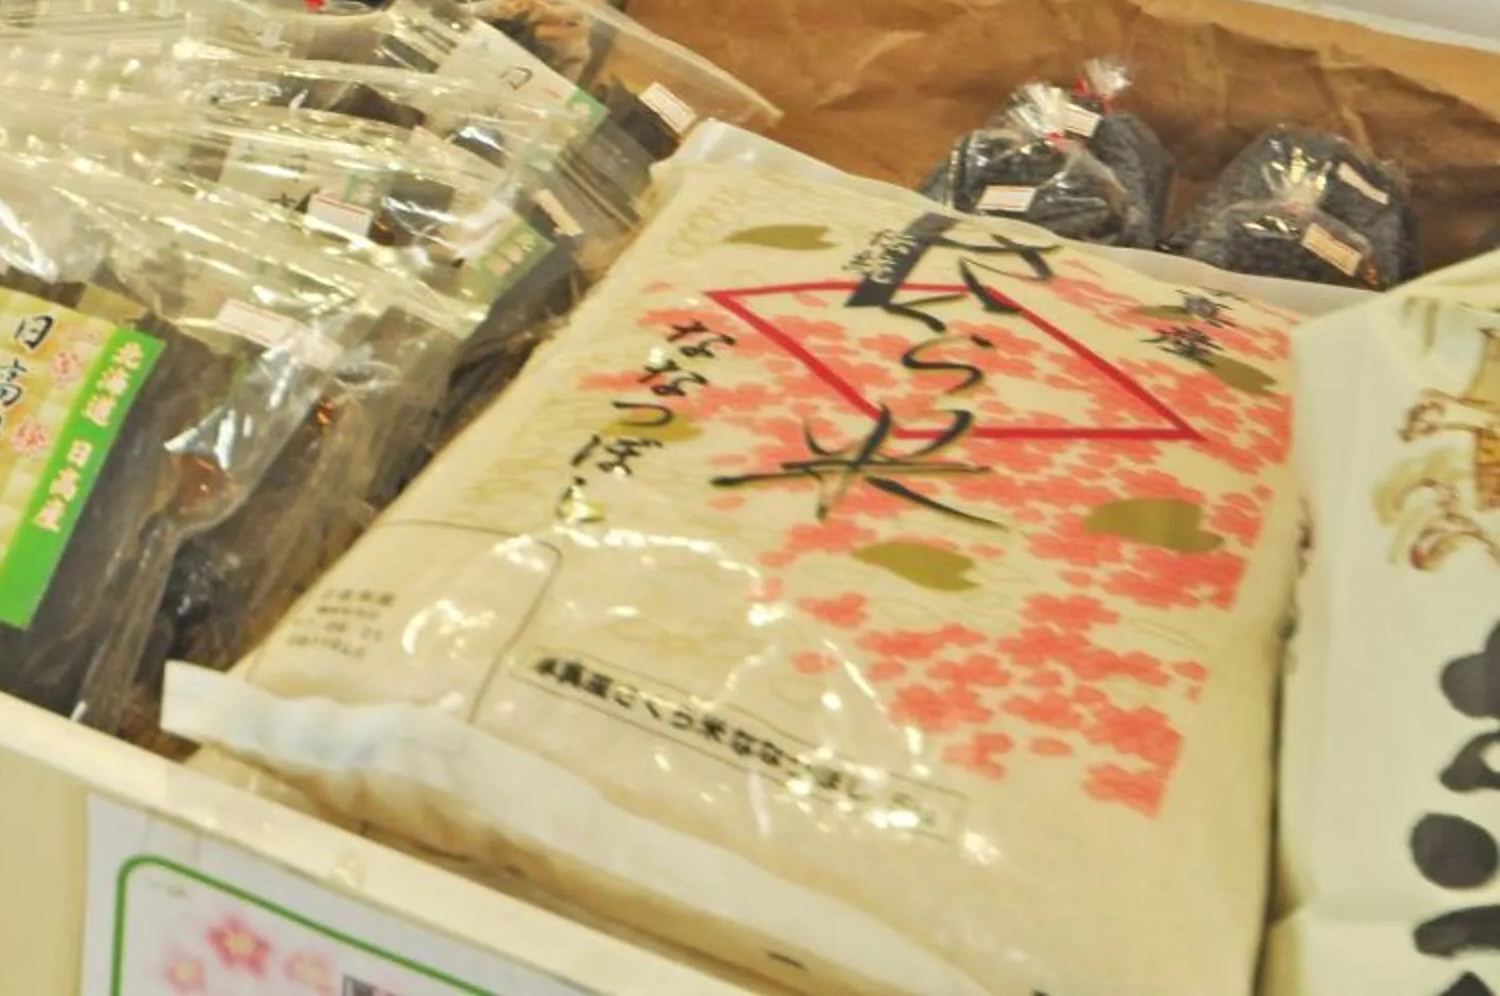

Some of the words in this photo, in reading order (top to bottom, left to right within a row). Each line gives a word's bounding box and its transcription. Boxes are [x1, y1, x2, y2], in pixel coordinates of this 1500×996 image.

[82, 340, 145, 429] 北海道
[33, 439, 94, 534] 日高産
